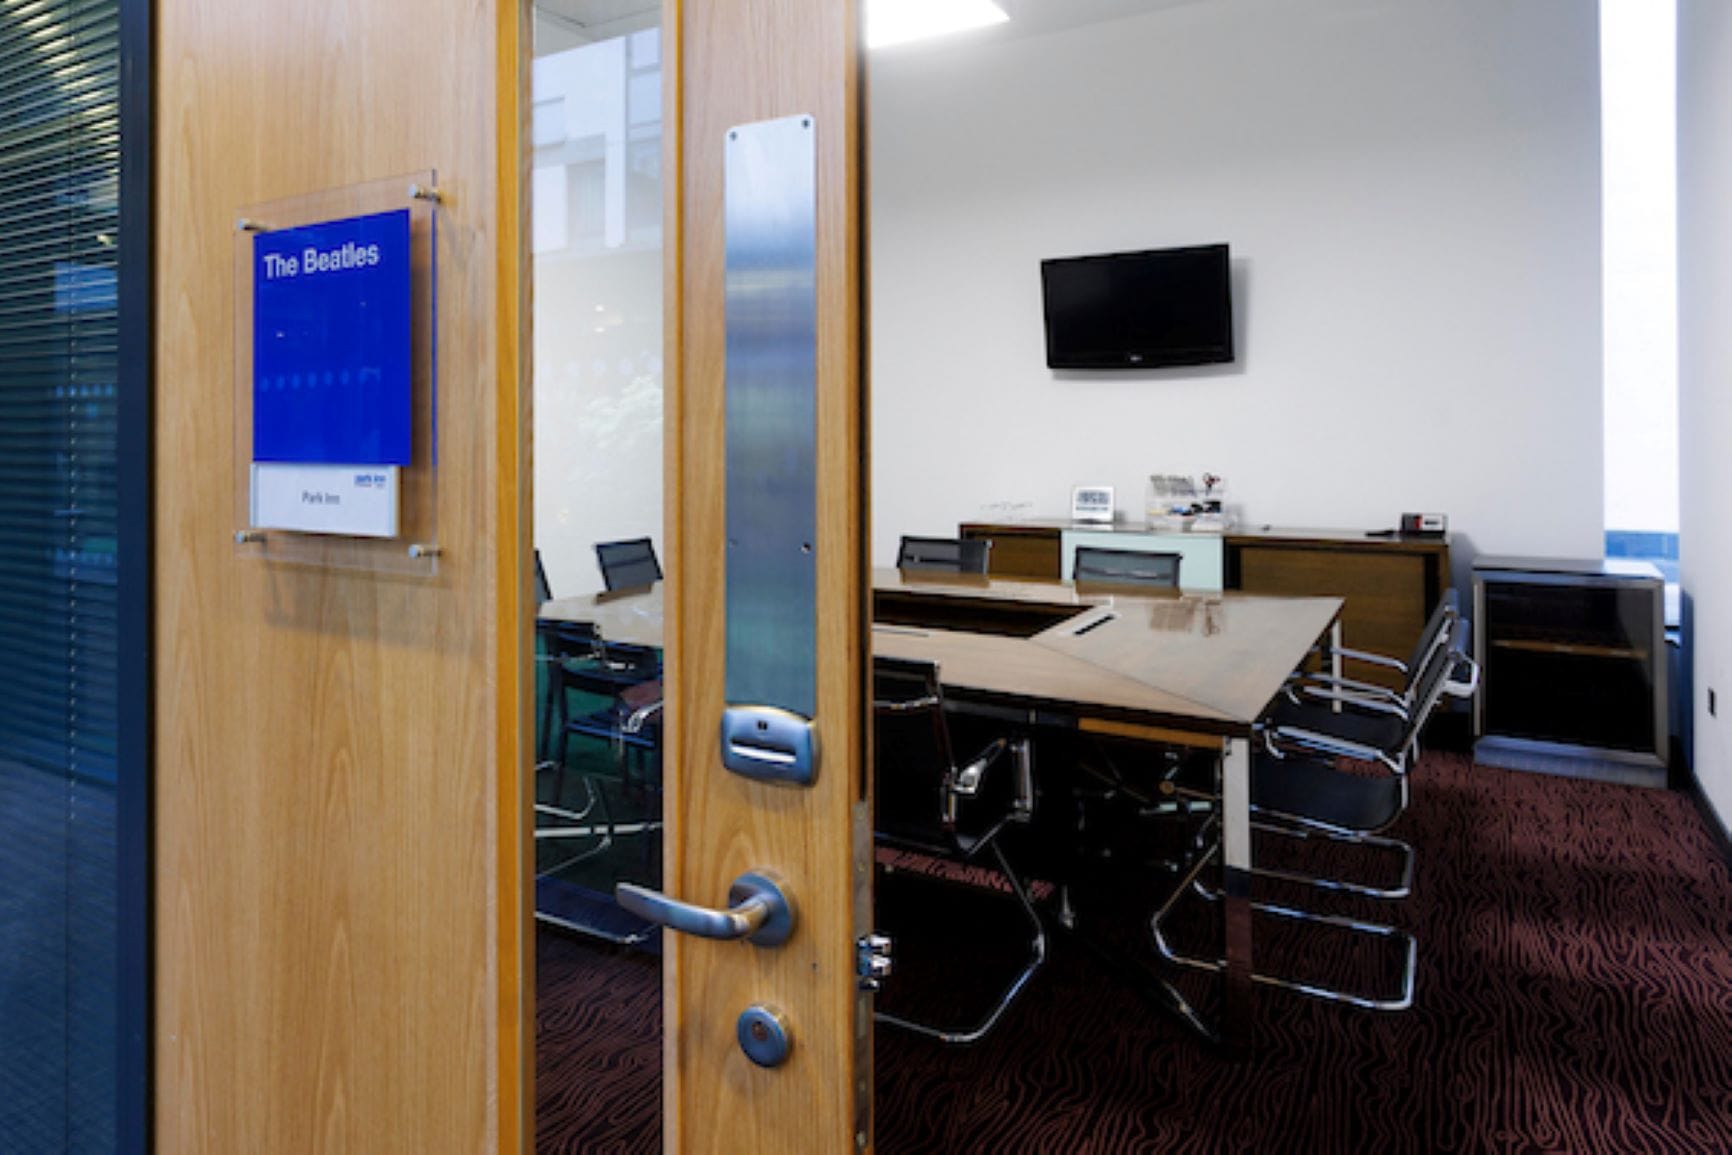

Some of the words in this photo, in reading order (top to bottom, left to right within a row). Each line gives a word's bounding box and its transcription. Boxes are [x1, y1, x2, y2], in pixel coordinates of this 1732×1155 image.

[263, 253, 298, 279] The
[303, 241, 379, 274] Beatles
[301, 490, 323, 504] Park
